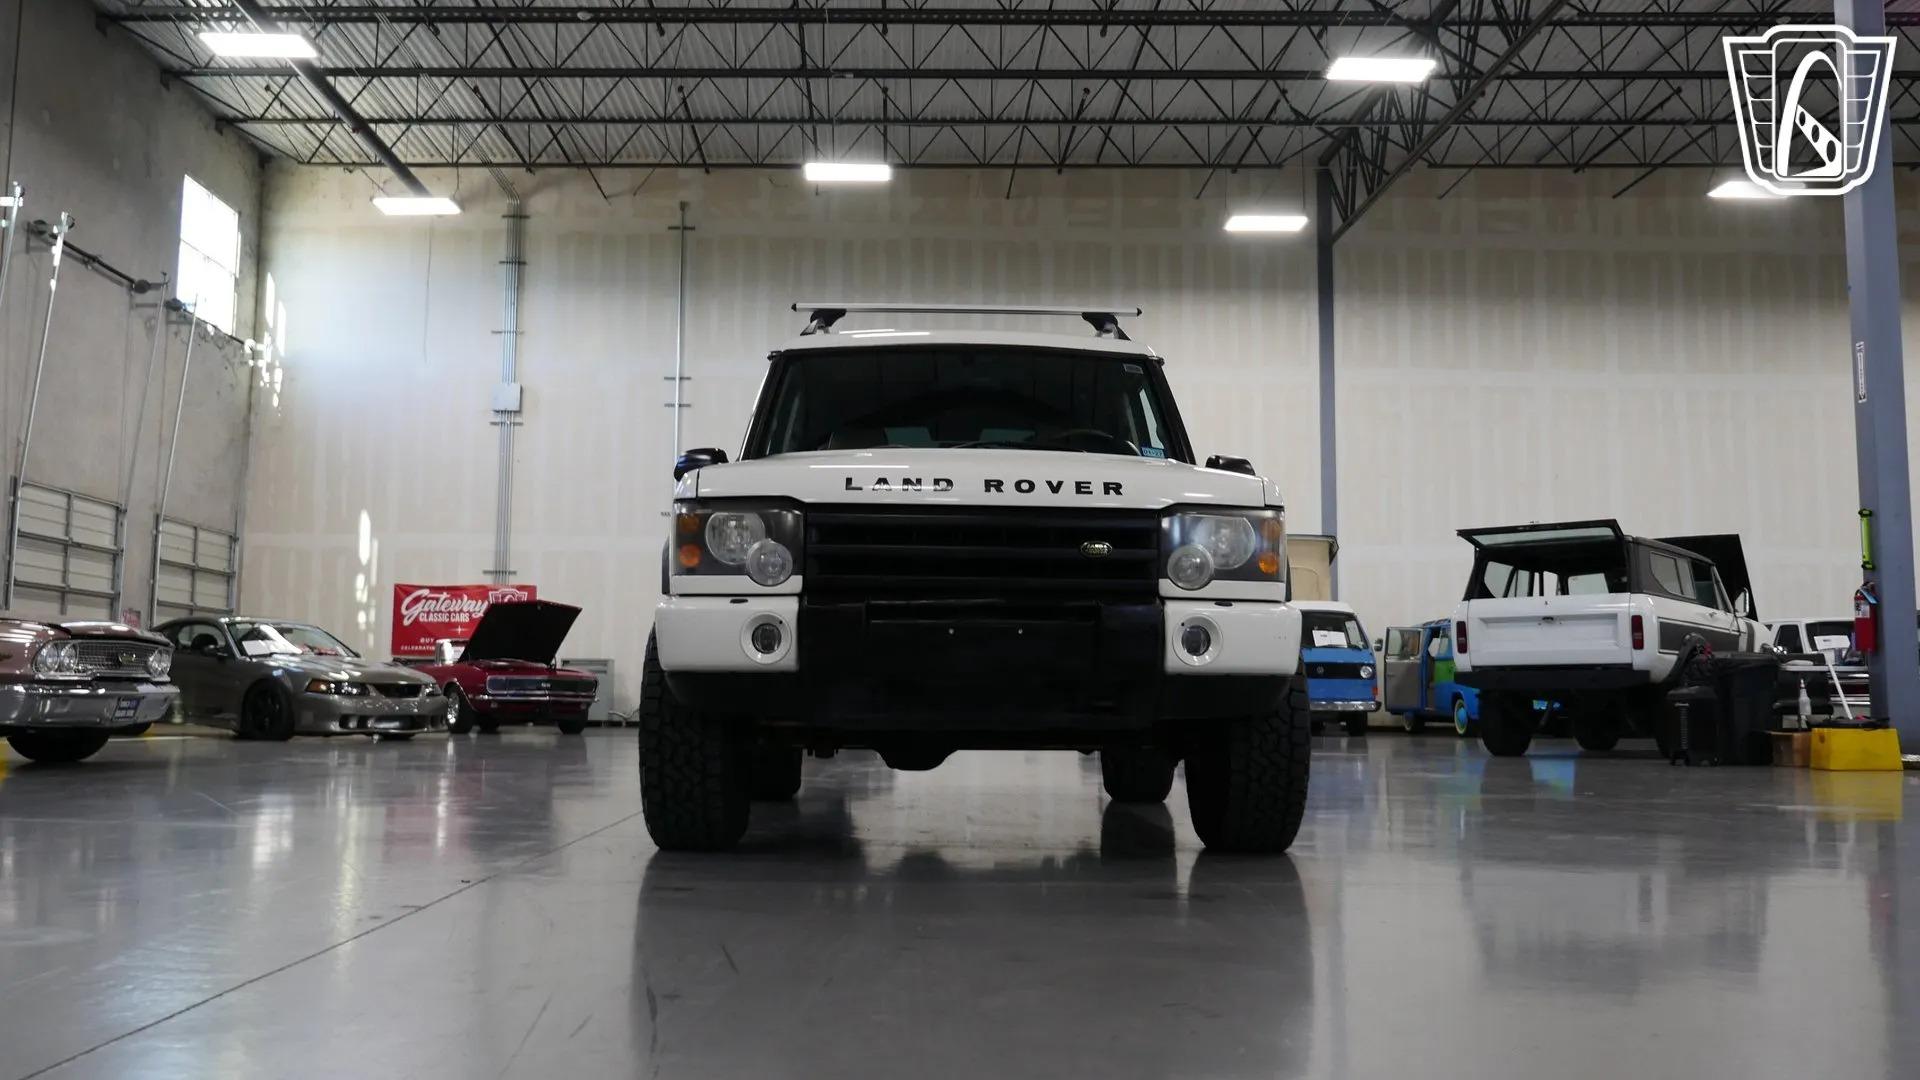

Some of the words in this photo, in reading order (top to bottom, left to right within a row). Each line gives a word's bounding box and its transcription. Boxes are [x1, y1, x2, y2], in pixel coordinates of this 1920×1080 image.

[845, 477, 954, 492] LAND
[984, 479, 1123, 496] ROVER
[402, 589, 489, 626] Gateway
[419, 613, 449, 622] CLASSIC
[450, 613, 470, 622] CARS
